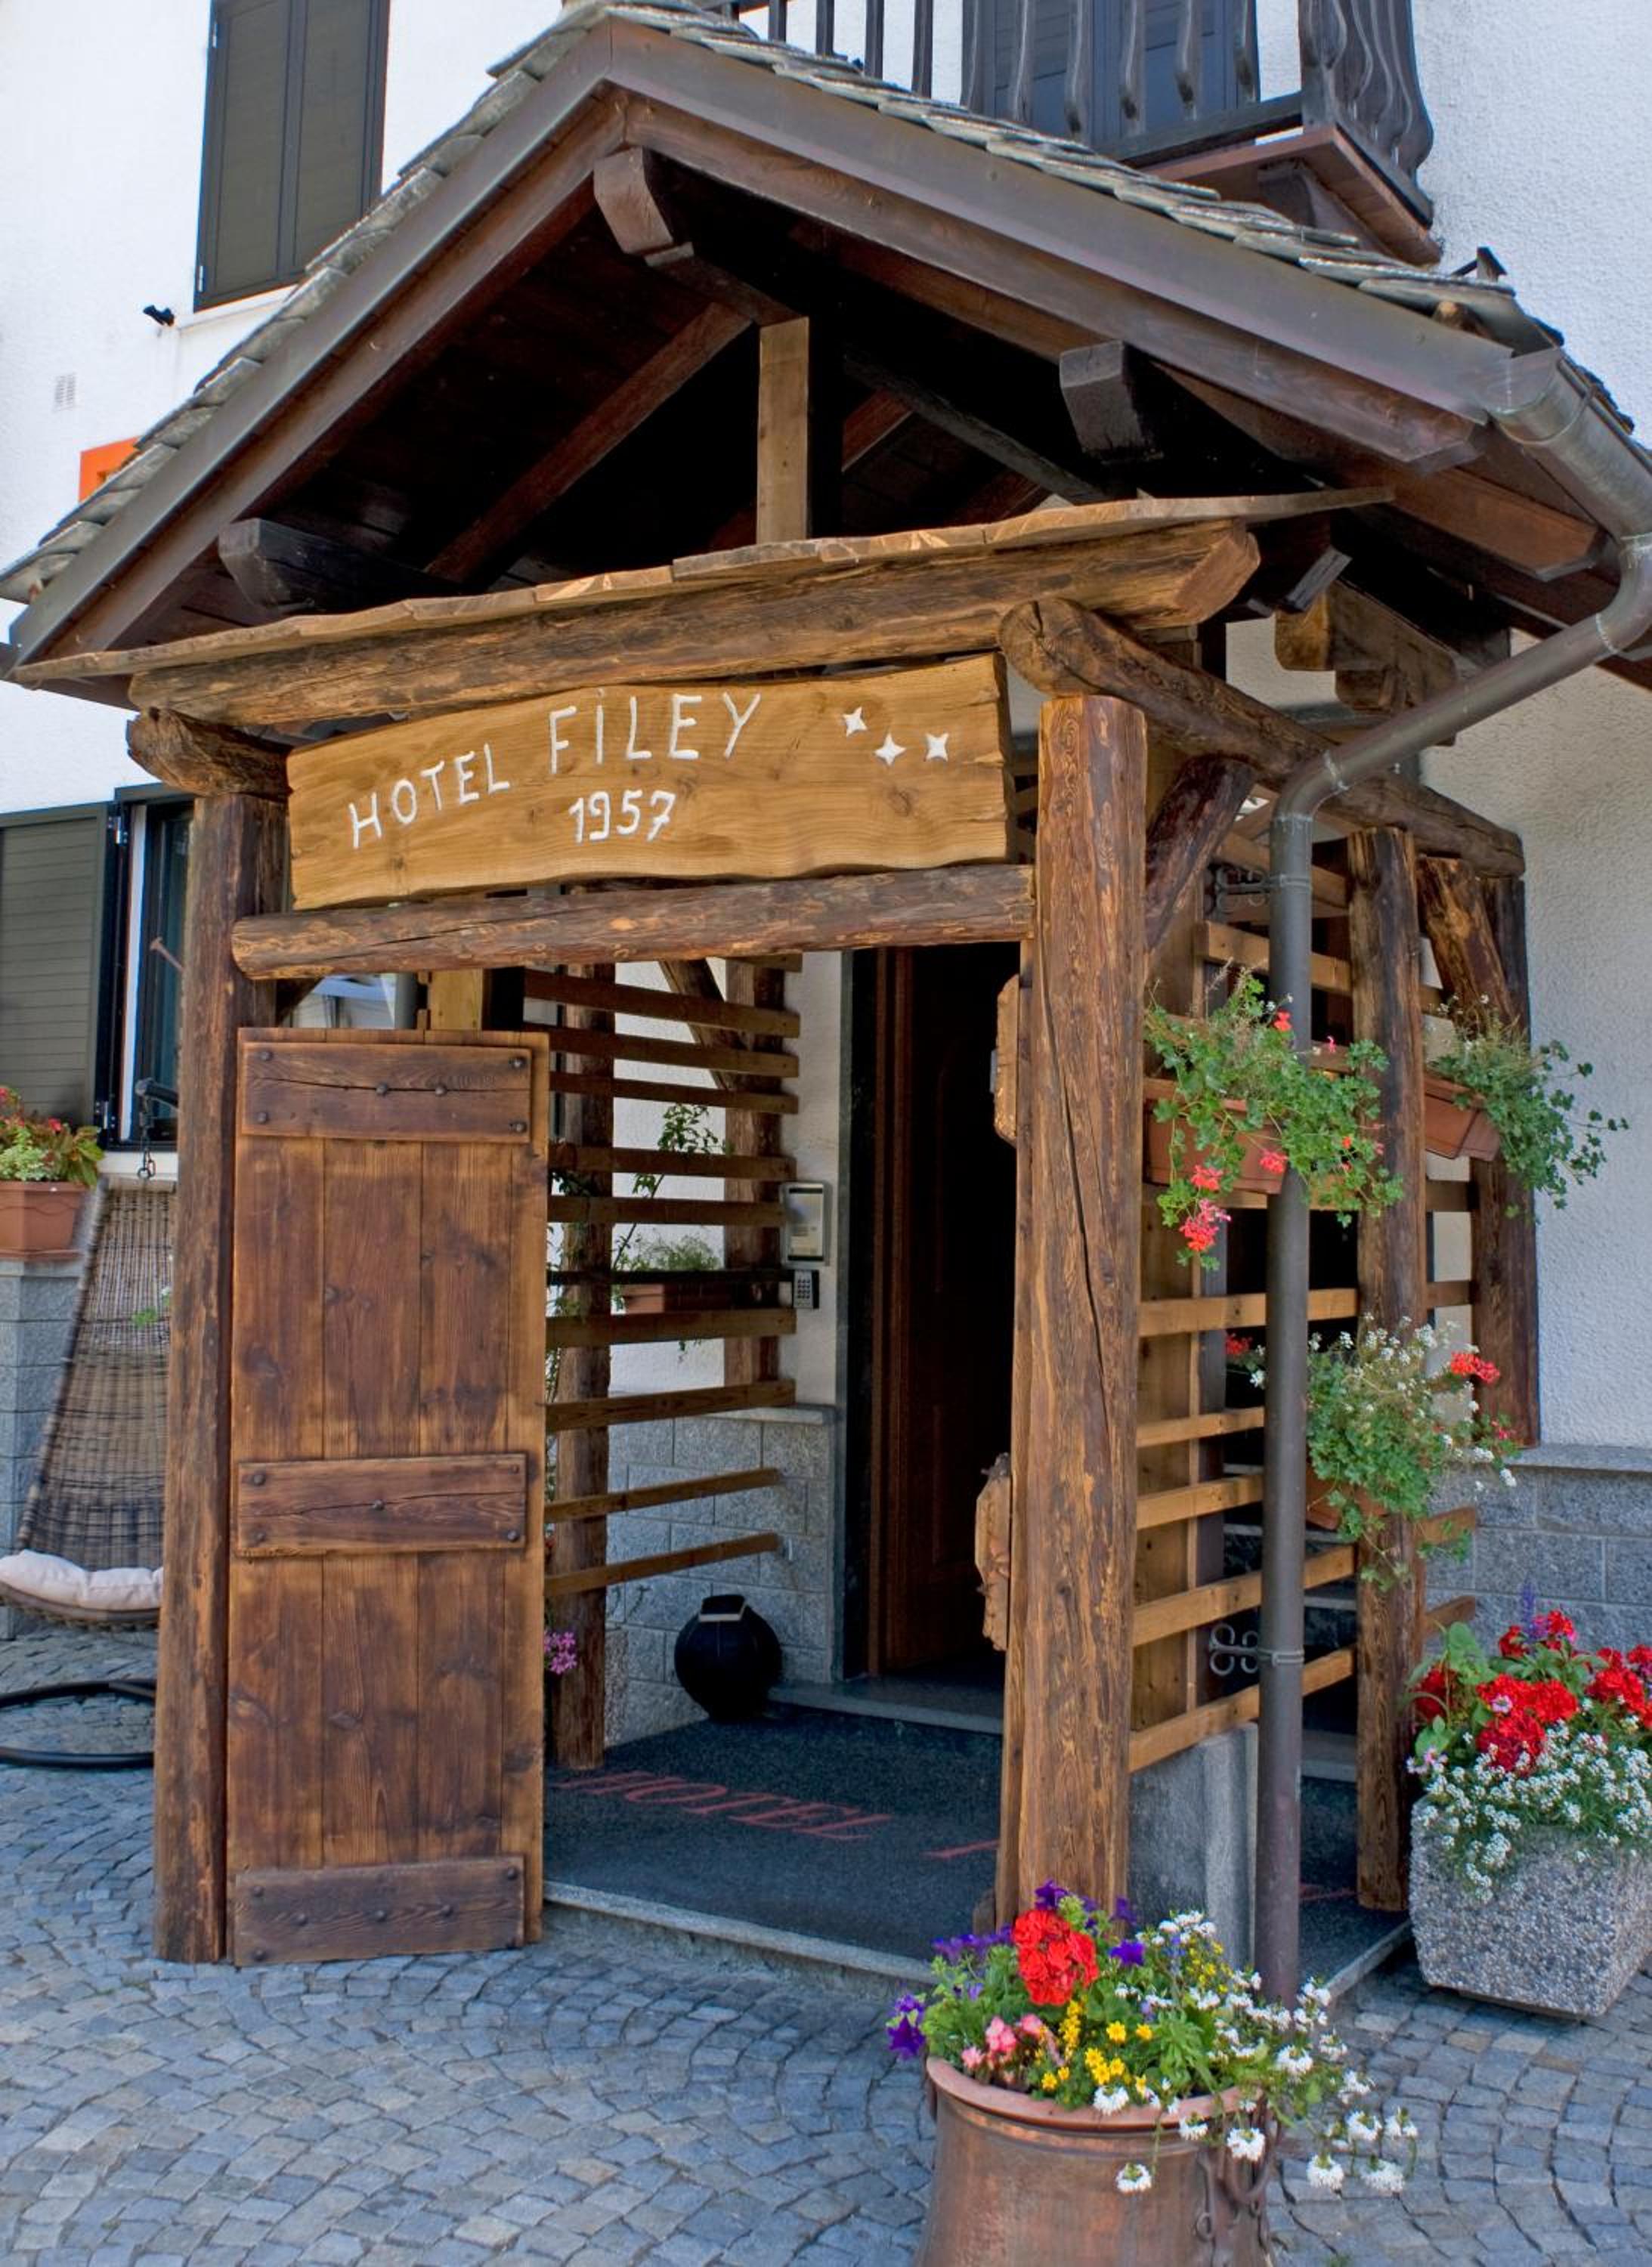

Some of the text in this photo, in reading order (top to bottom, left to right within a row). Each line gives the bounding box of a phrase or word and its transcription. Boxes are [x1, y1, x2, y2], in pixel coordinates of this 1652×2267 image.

[348, 691, 762, 849] HOTEL FILEY
[568, 788, 678, 844] 1957
[553, 1770, 893, 1841] HOTEL
